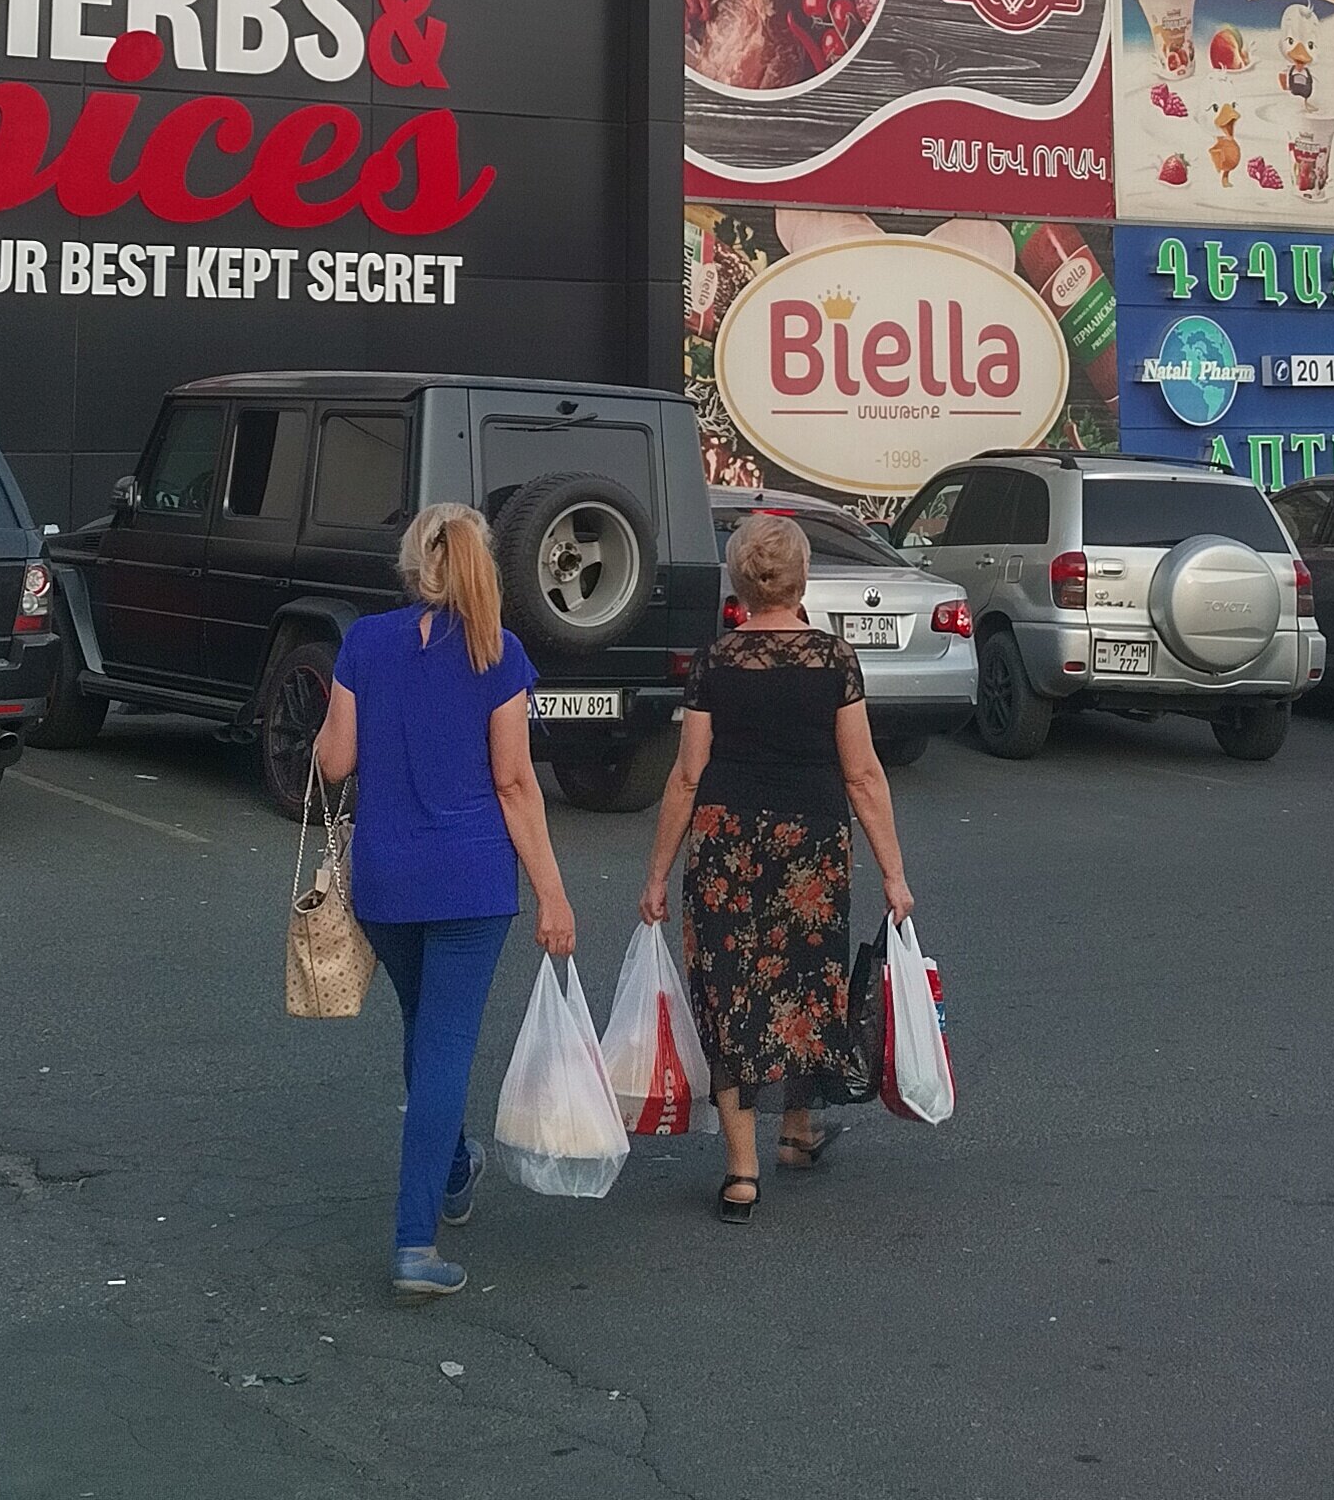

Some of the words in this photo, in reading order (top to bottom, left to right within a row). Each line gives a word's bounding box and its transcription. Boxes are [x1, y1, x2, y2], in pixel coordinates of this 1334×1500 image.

[60, 240, 175, 299] BEST
[186, 245, 299, 301] KEPT
[307, 251, 463, 305] SECRET
[1055, 264, 1087, 298] Biella
[770, 299, 1021, 398] Biella
[1142, 359, 1191, 381] Natali
[1198, 360, 1255, 383] Pharm
[1296, 359, 1319, 382] 20
[1204, 600, 1252, 613] TOYOTA
[860, 617, 874, 630] 37
[878, 617, 893, 631] ON
[868, 631, 887, 645] 188
[1113, 644, 1127, 657] 97
[1131, 645, 1147, 658] MM
[1119, 658, 1139, 671] 777
[539, 697, 557, 716] 37
[562, 697, 583, 716] NV
[587, 697, 613, 716] 891
